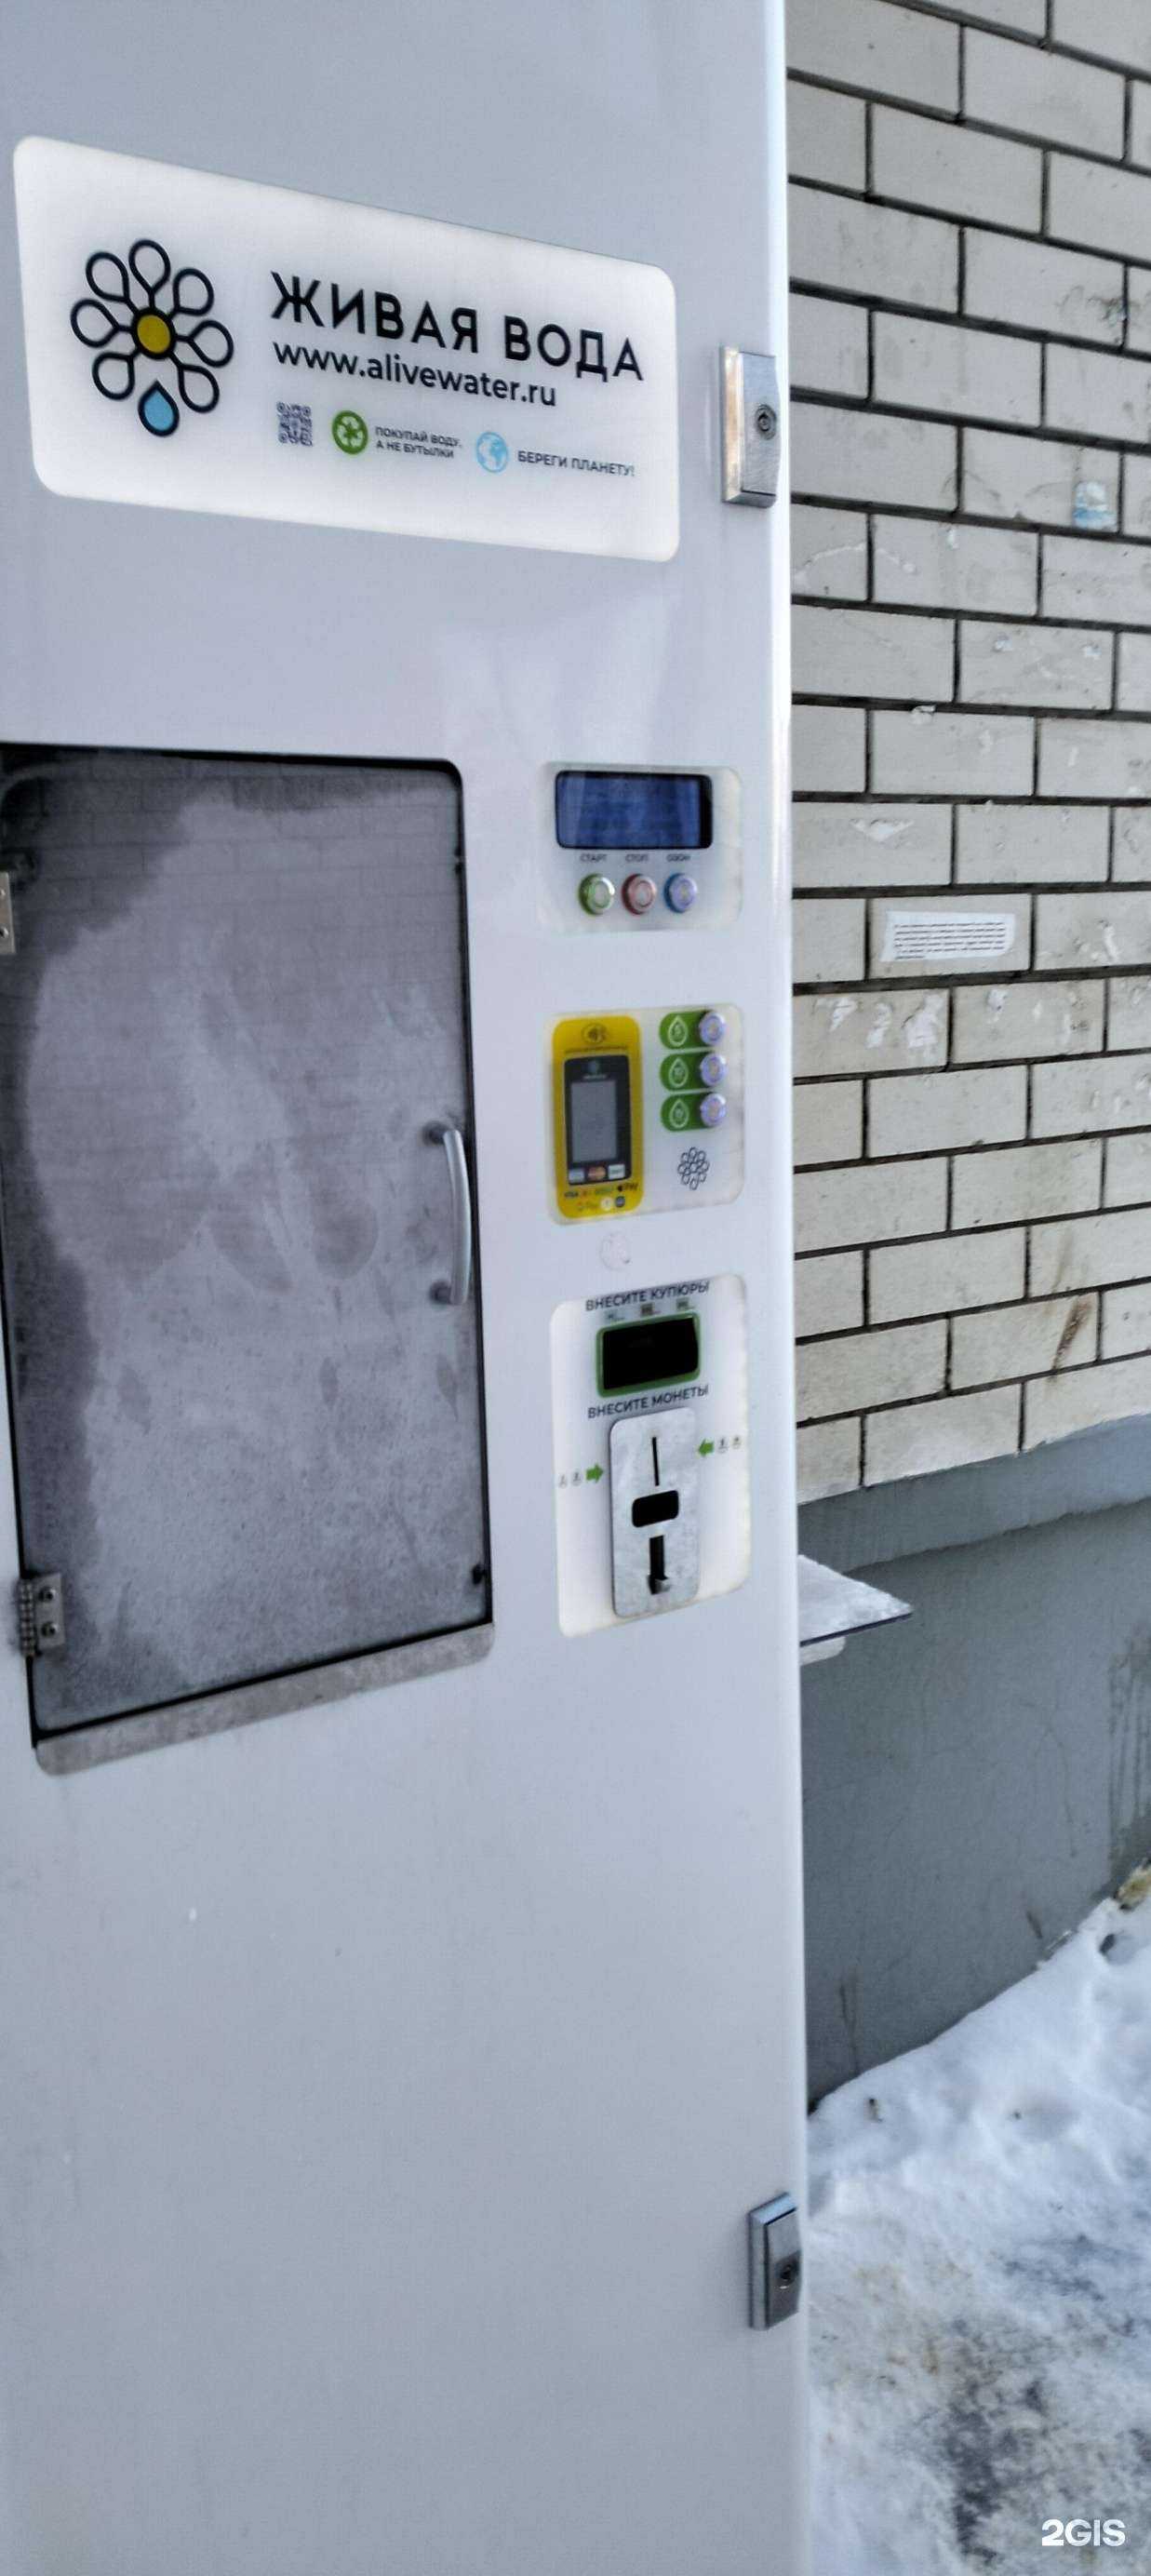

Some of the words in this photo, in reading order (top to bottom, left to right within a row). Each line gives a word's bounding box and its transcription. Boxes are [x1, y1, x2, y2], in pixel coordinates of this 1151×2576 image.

[271, 272, 478, 354] ЖИВАЯ
[504, 315, 644, 382] ВОДА
[272, 342, 557, 407] www.alivewater.ru
[375, 425, 428, 442] ПОКУПАЙ
[376, 439, 384, 450] А
[386, 441, 402, 452] НЕ
[404, 443, 455, 459] БУТЫЛКИ
[517, 449, 569, 469] БЕРЕГИ
[571, 457, 636, 476] ПЛАНЕТУ!
[585, 1290, 647, 1312] ВНЕСИТЕ
[650, 1281, 709, 1300] КУПЮРЫ
[587, 1397, 649, 1419] ВНЕСИТЕ
[651, 1385, 709, 1405] МОНЕТЫ
